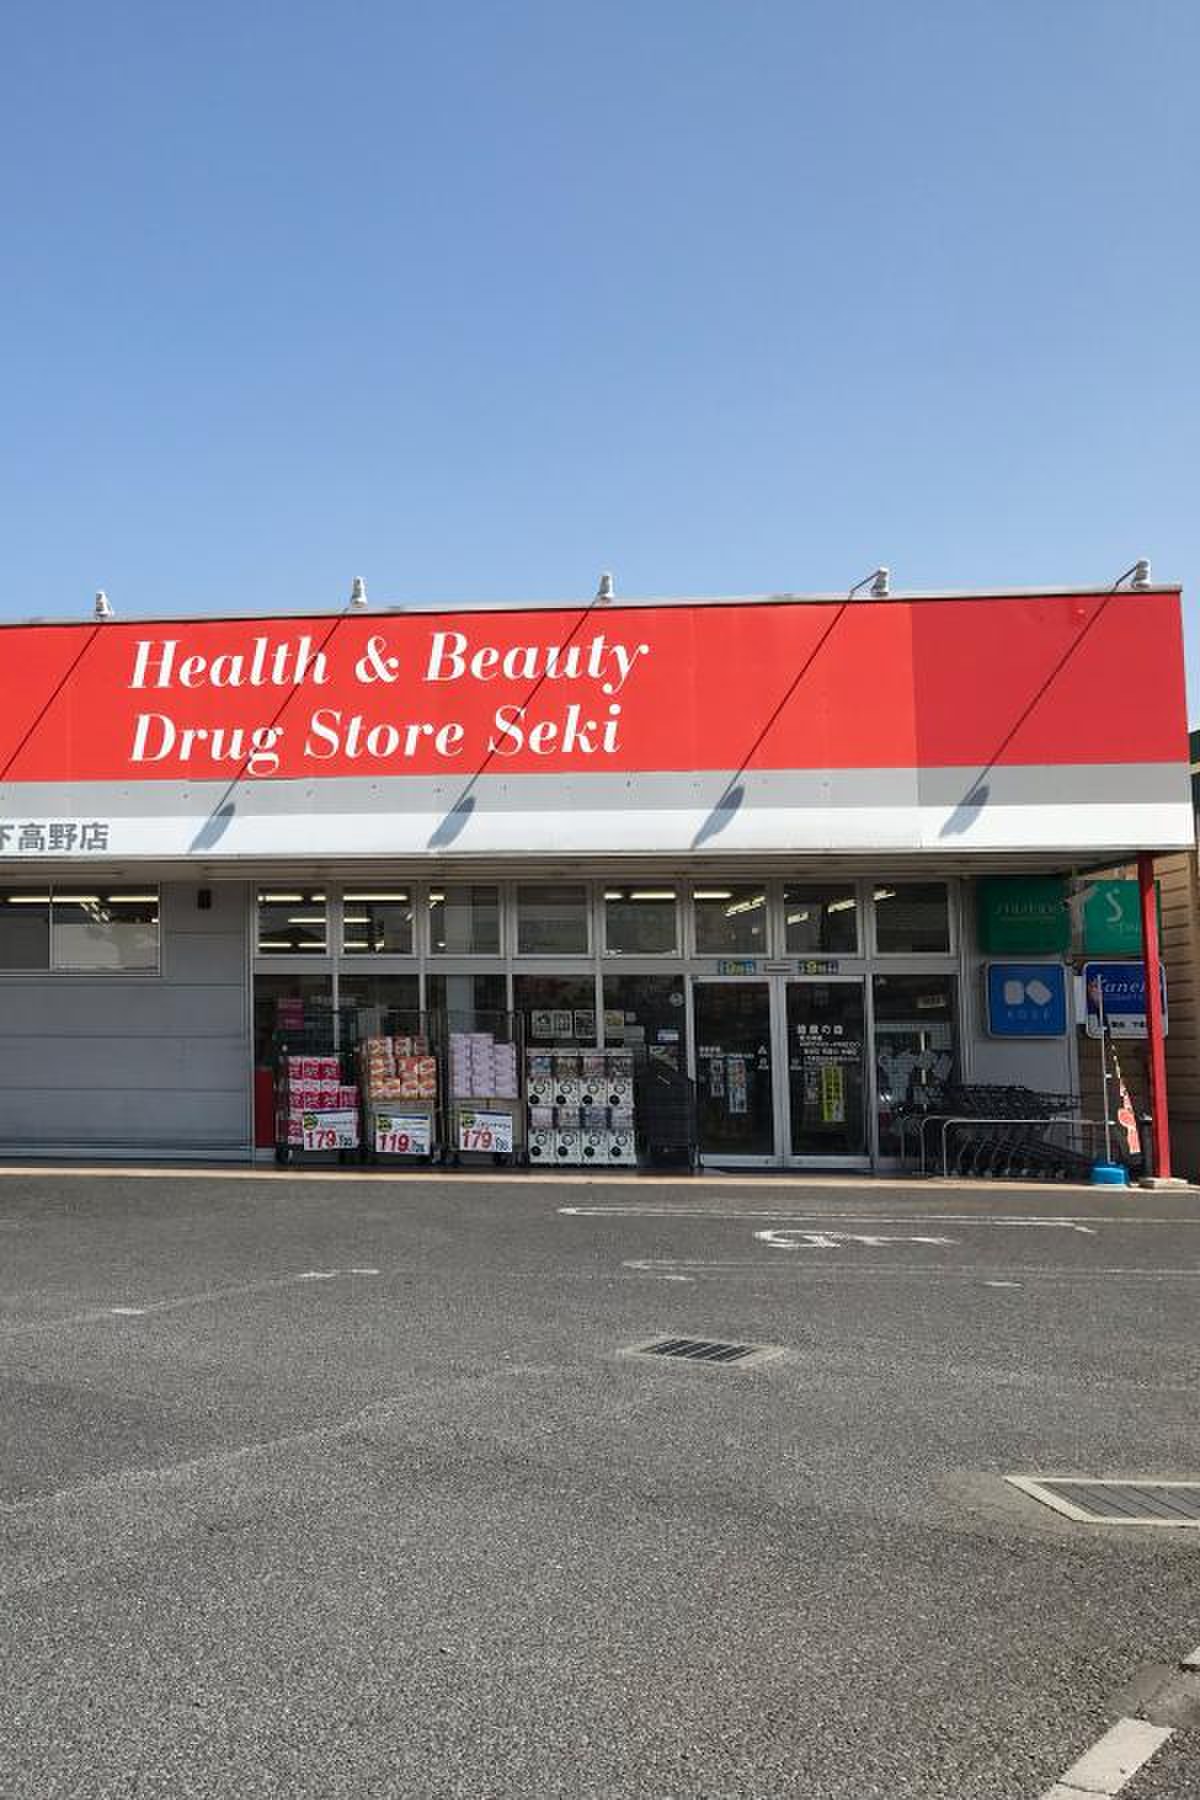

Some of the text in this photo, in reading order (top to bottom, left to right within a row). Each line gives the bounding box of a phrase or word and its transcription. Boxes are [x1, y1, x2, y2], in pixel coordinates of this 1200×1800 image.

[128, 630, 650, 695] Health & Beauty
[129, 704, 622, 774] Drug Store Seki
